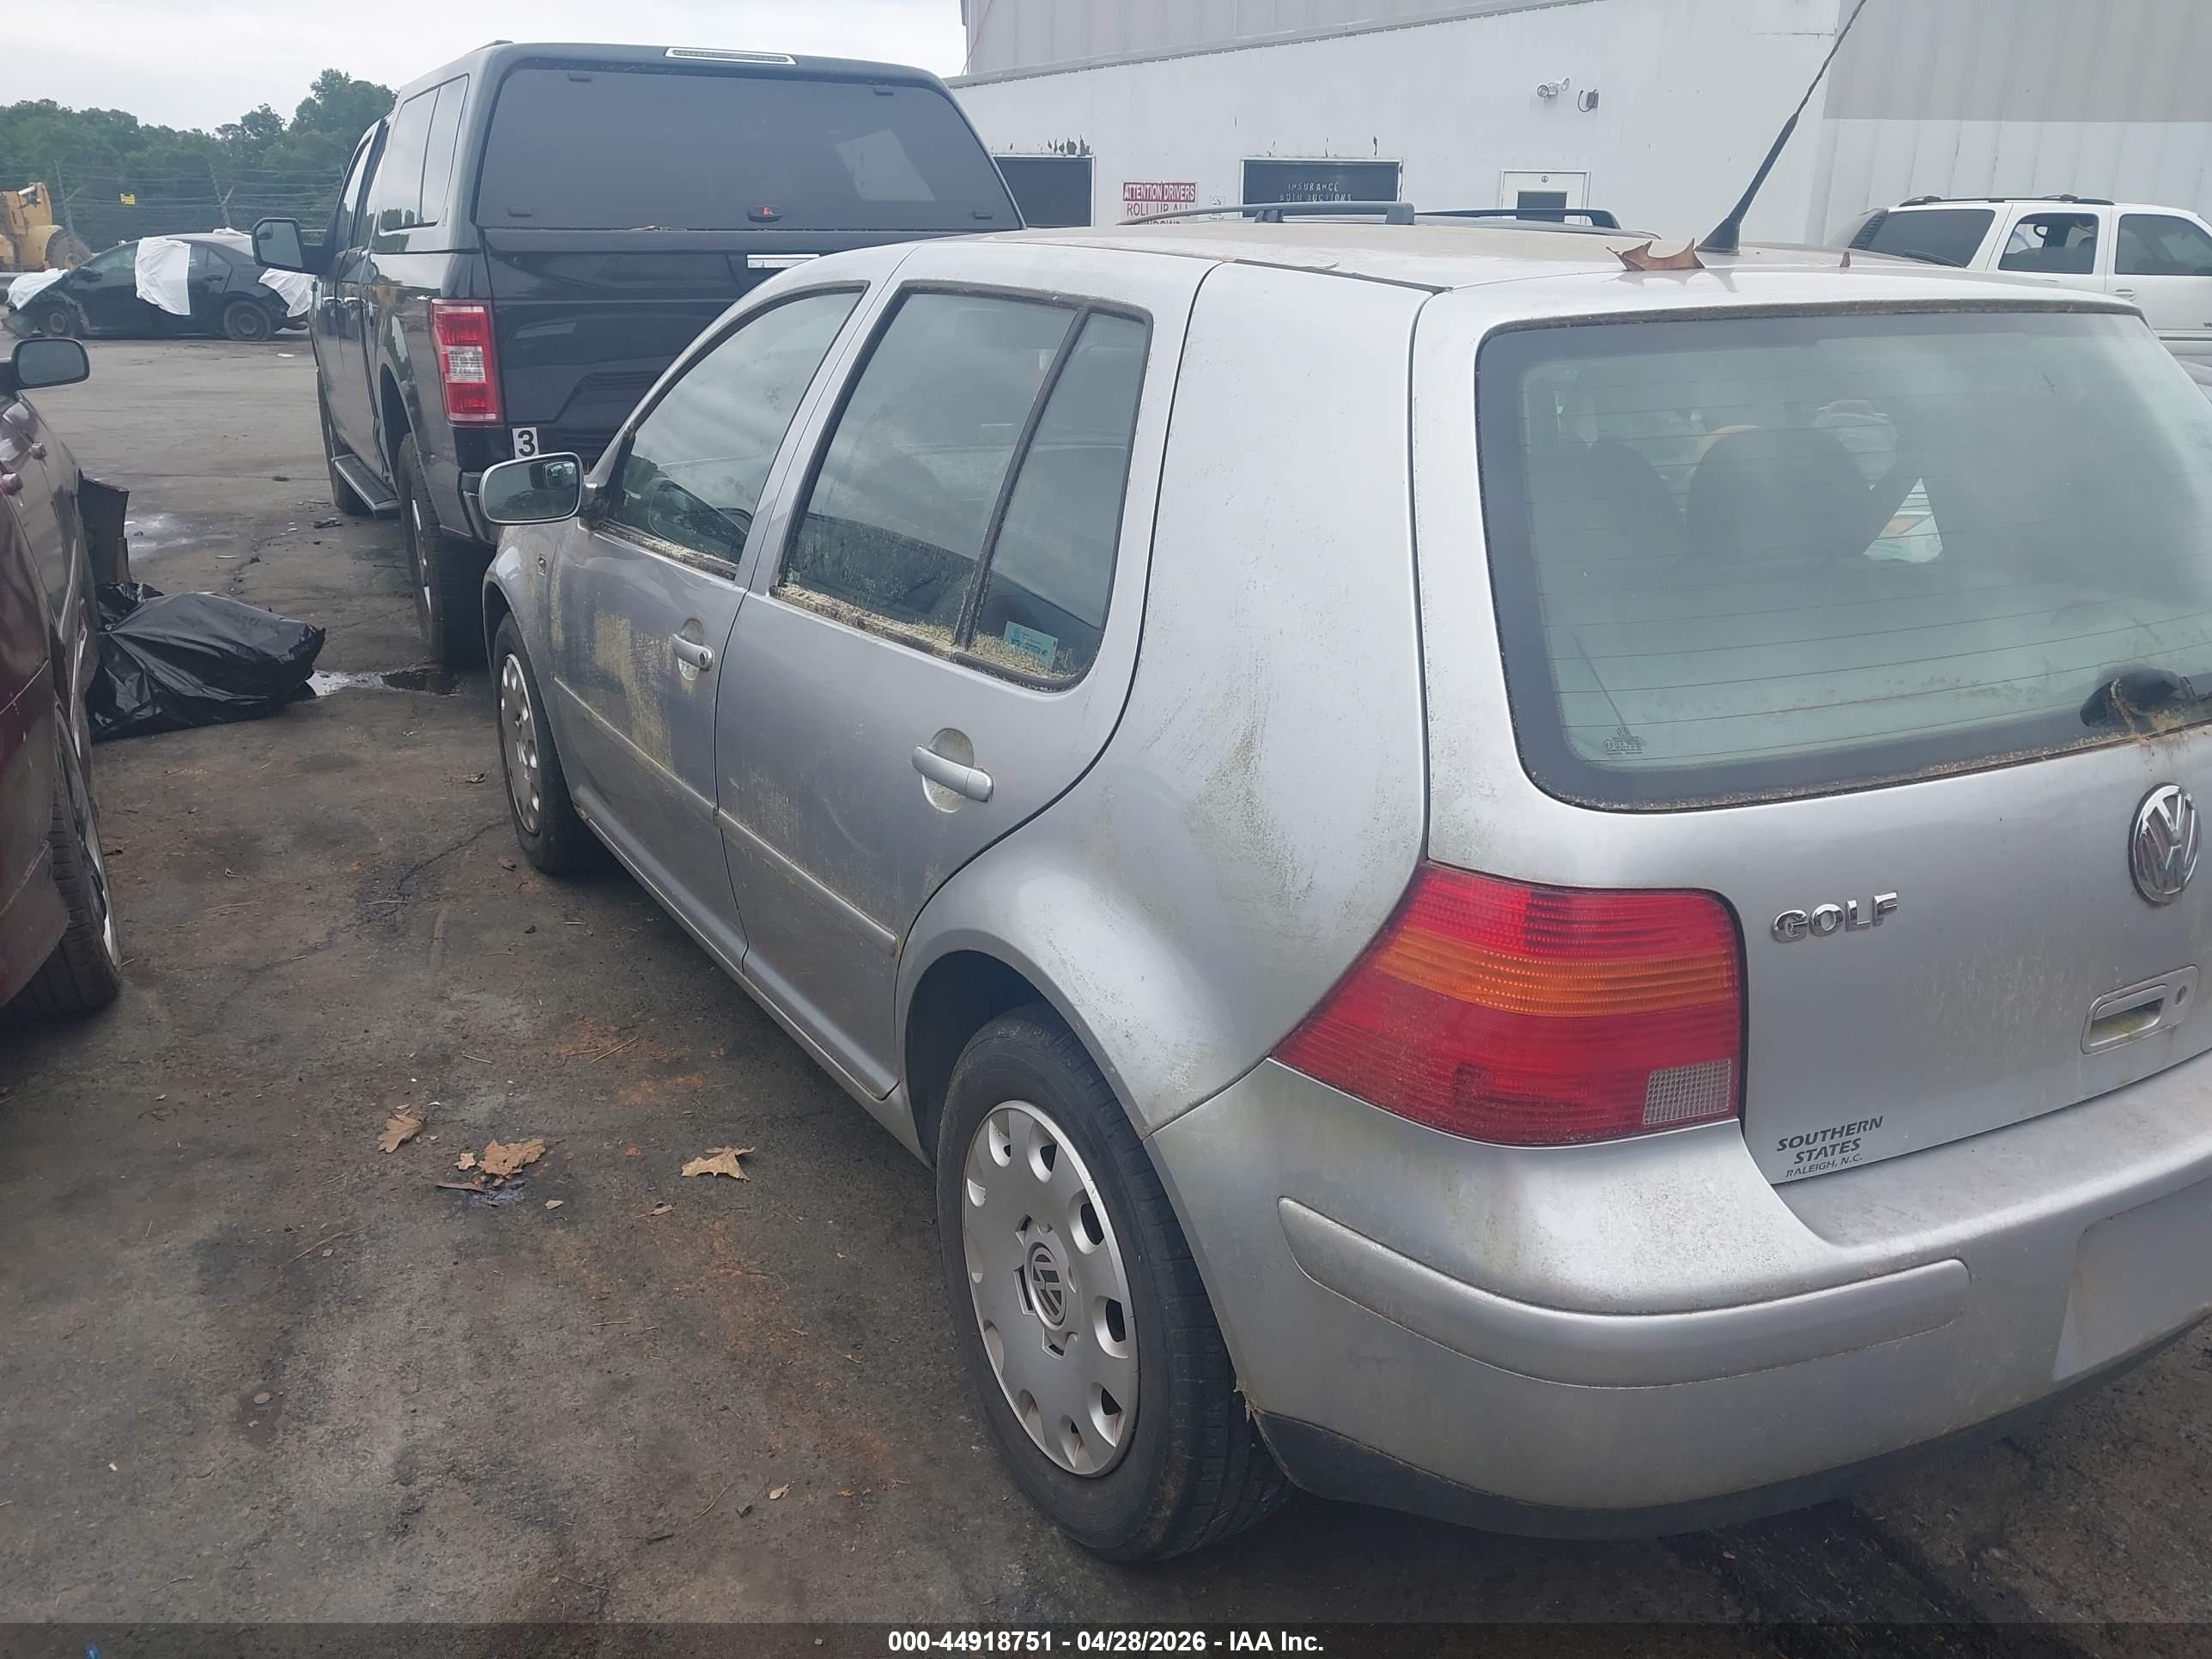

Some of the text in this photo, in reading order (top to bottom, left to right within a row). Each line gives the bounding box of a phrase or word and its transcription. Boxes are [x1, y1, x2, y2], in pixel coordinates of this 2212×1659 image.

[1123, 183, 1195, 201] ATTENTION DRIVERS
[1288, 181, 1340, 191] INSURANCE
[1127, 203, 1149, 216] ROLL
[517, 429, 536, 457] 3
[1771, 891, 1899, 943] GOLF
[1776, 1115, 1883, 1152] SOUTHERN
[1793, 1138, 1862, 1164] STATES
[1786, 1153, 1863, 1178] RALEIGH, N.C.
